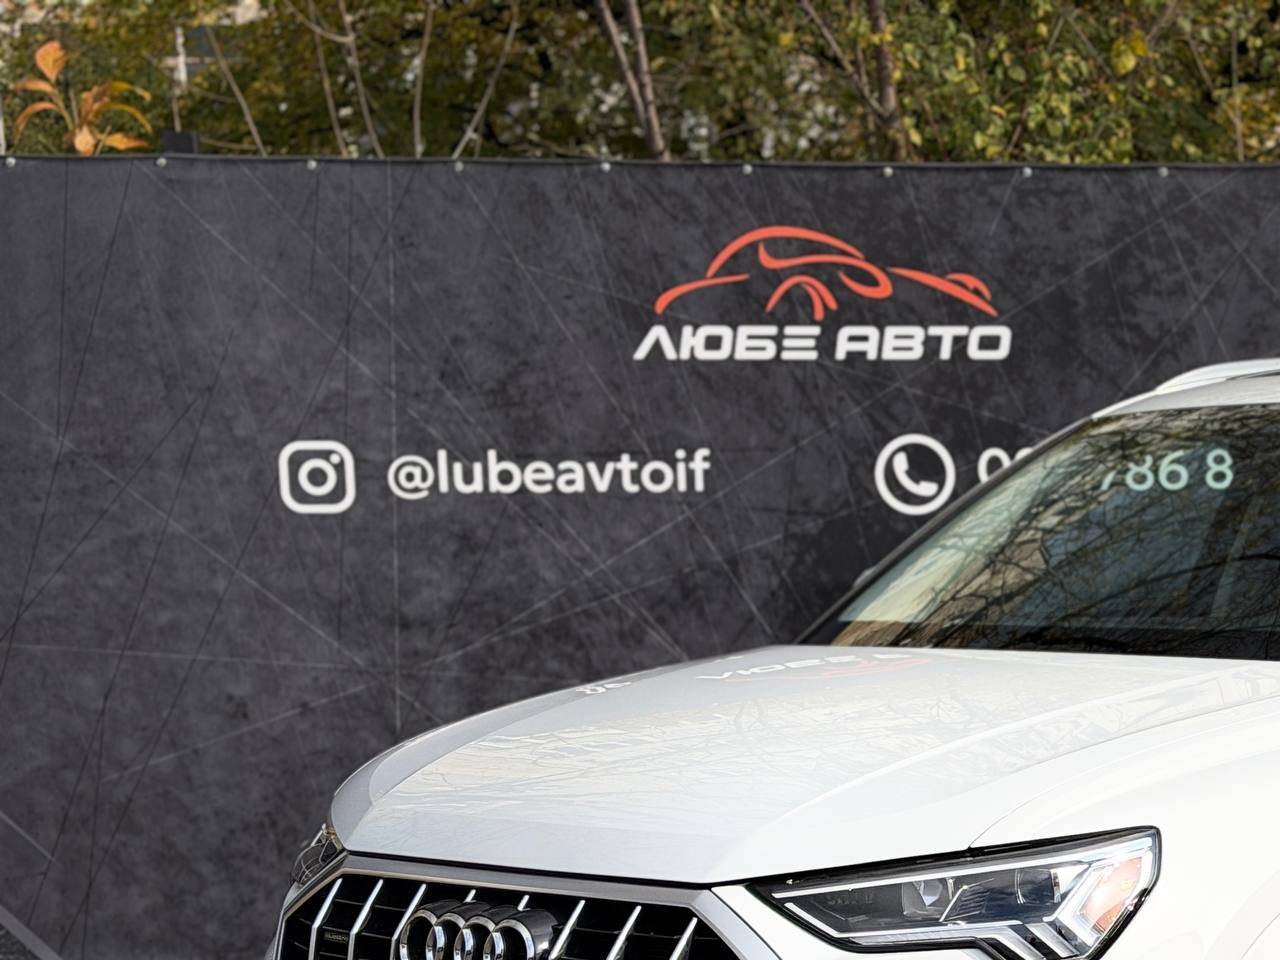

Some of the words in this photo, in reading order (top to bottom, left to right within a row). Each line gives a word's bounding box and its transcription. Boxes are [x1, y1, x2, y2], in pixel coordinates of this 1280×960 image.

[633, 324, 822, 361] ЛЮБЕ
[834, 324, 1013, 361] АВТО
[387, 448, 711, 500] @lubeavtoif
